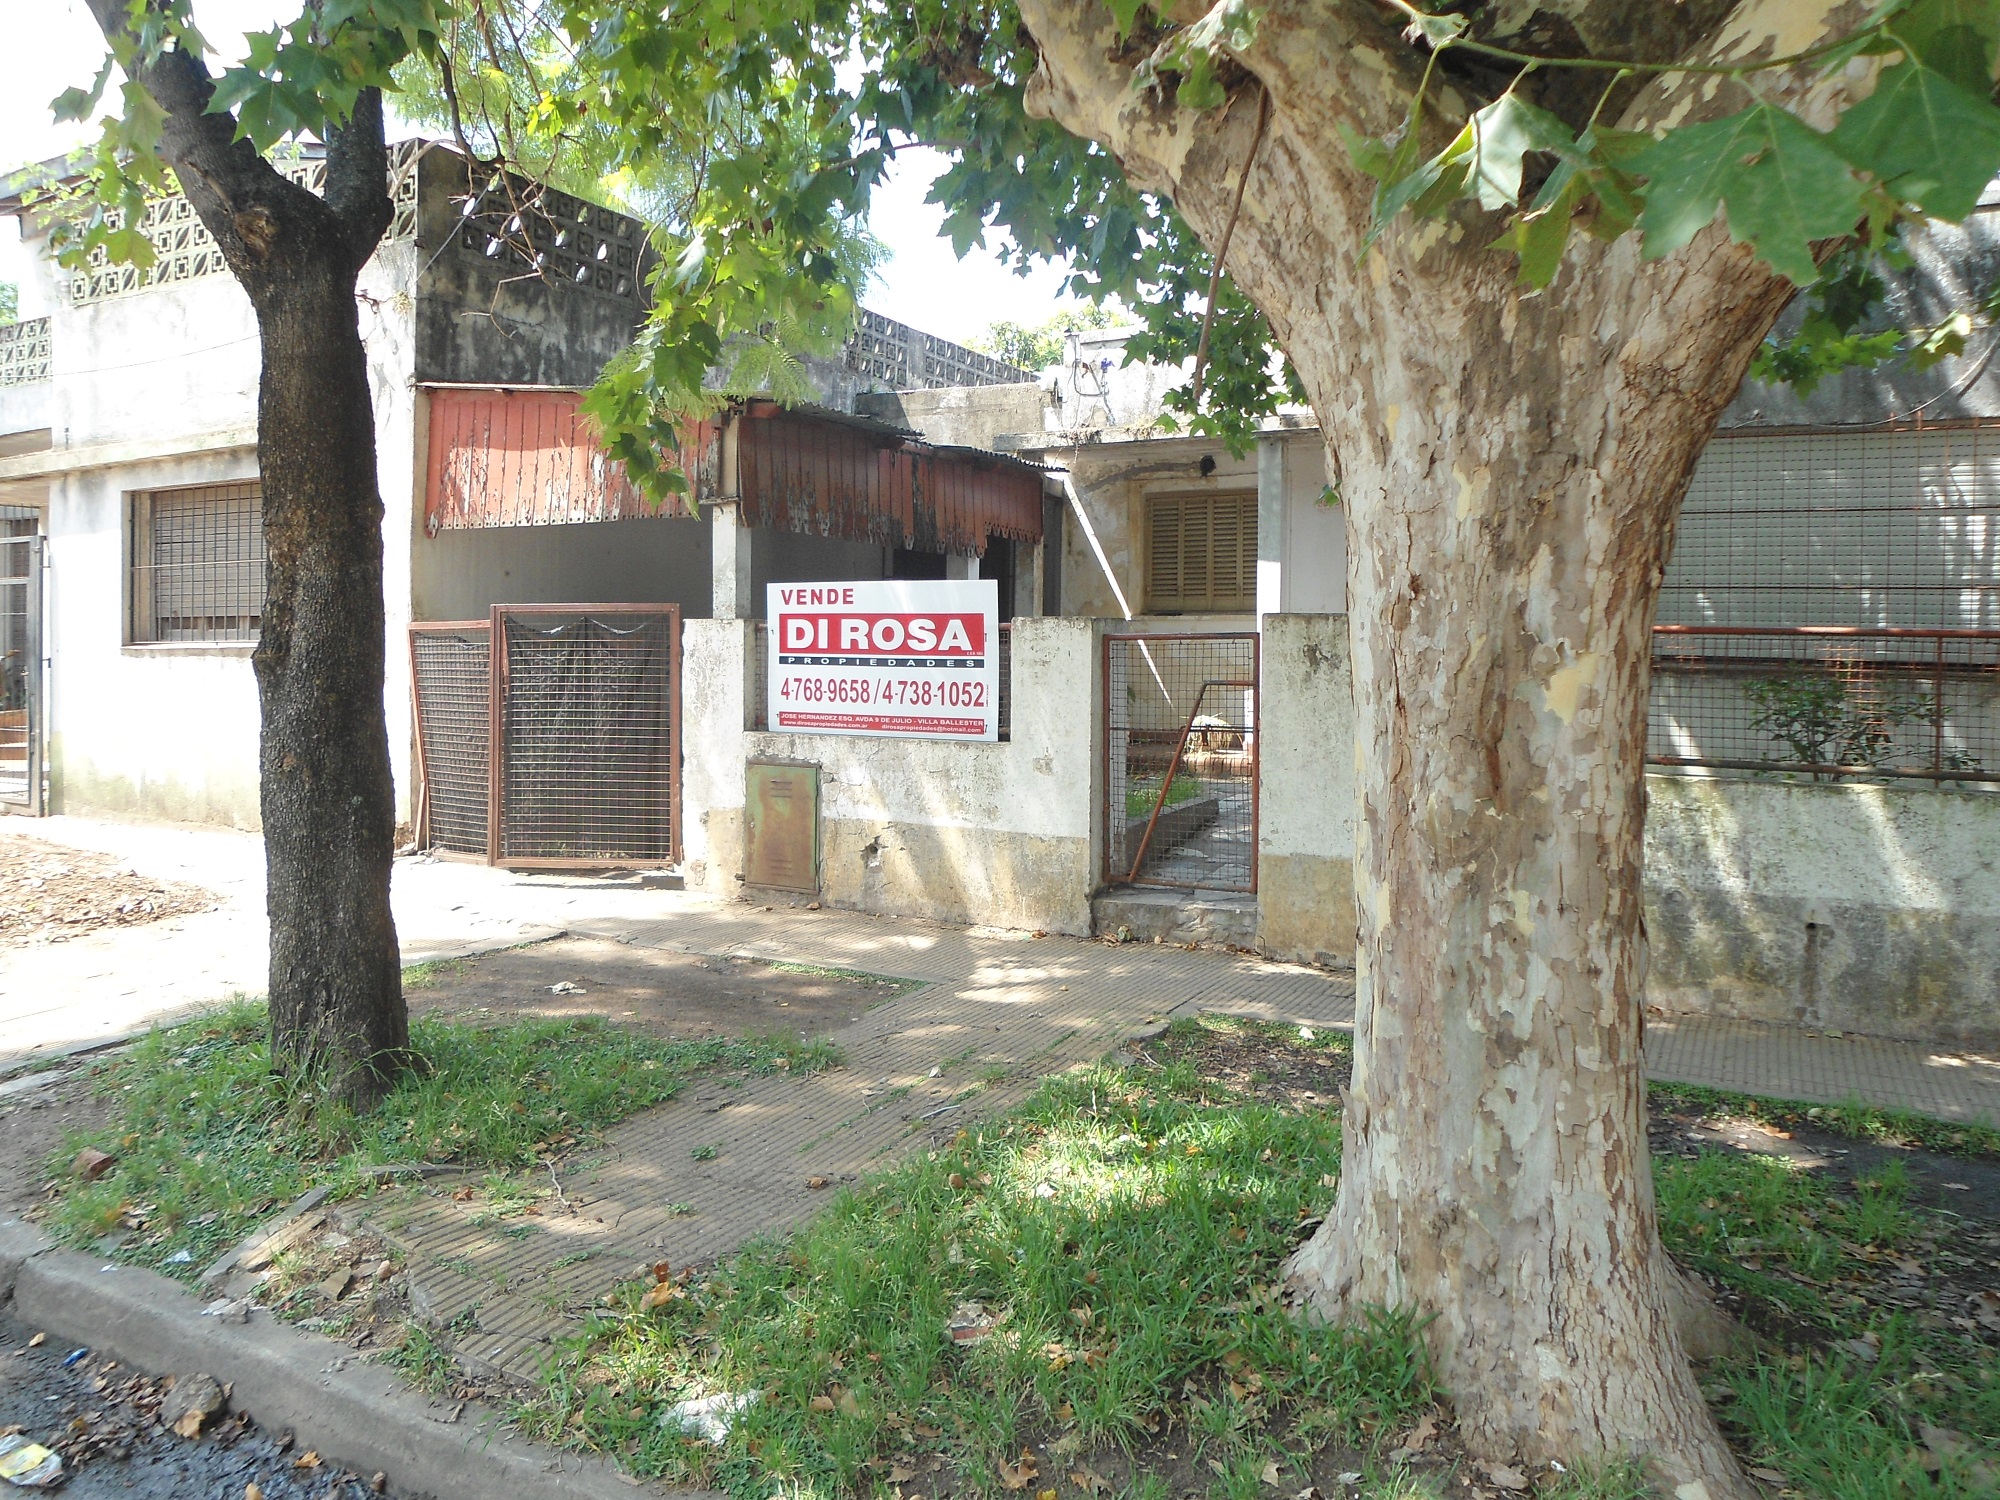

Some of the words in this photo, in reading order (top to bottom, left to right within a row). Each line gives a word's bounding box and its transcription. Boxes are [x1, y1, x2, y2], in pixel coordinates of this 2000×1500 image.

[781, 588, 854, 606] VENDE
[787, 618, 828, 649] DI
[840, 618, 973, 651] ROSA
[788, 657, 975, 667] PROPIEDADES
[783, 720, 868, 728] www.dirosapropiedades.com.ar
[881, 724, 981, 733] dirosapropiedades@hotmail.com
